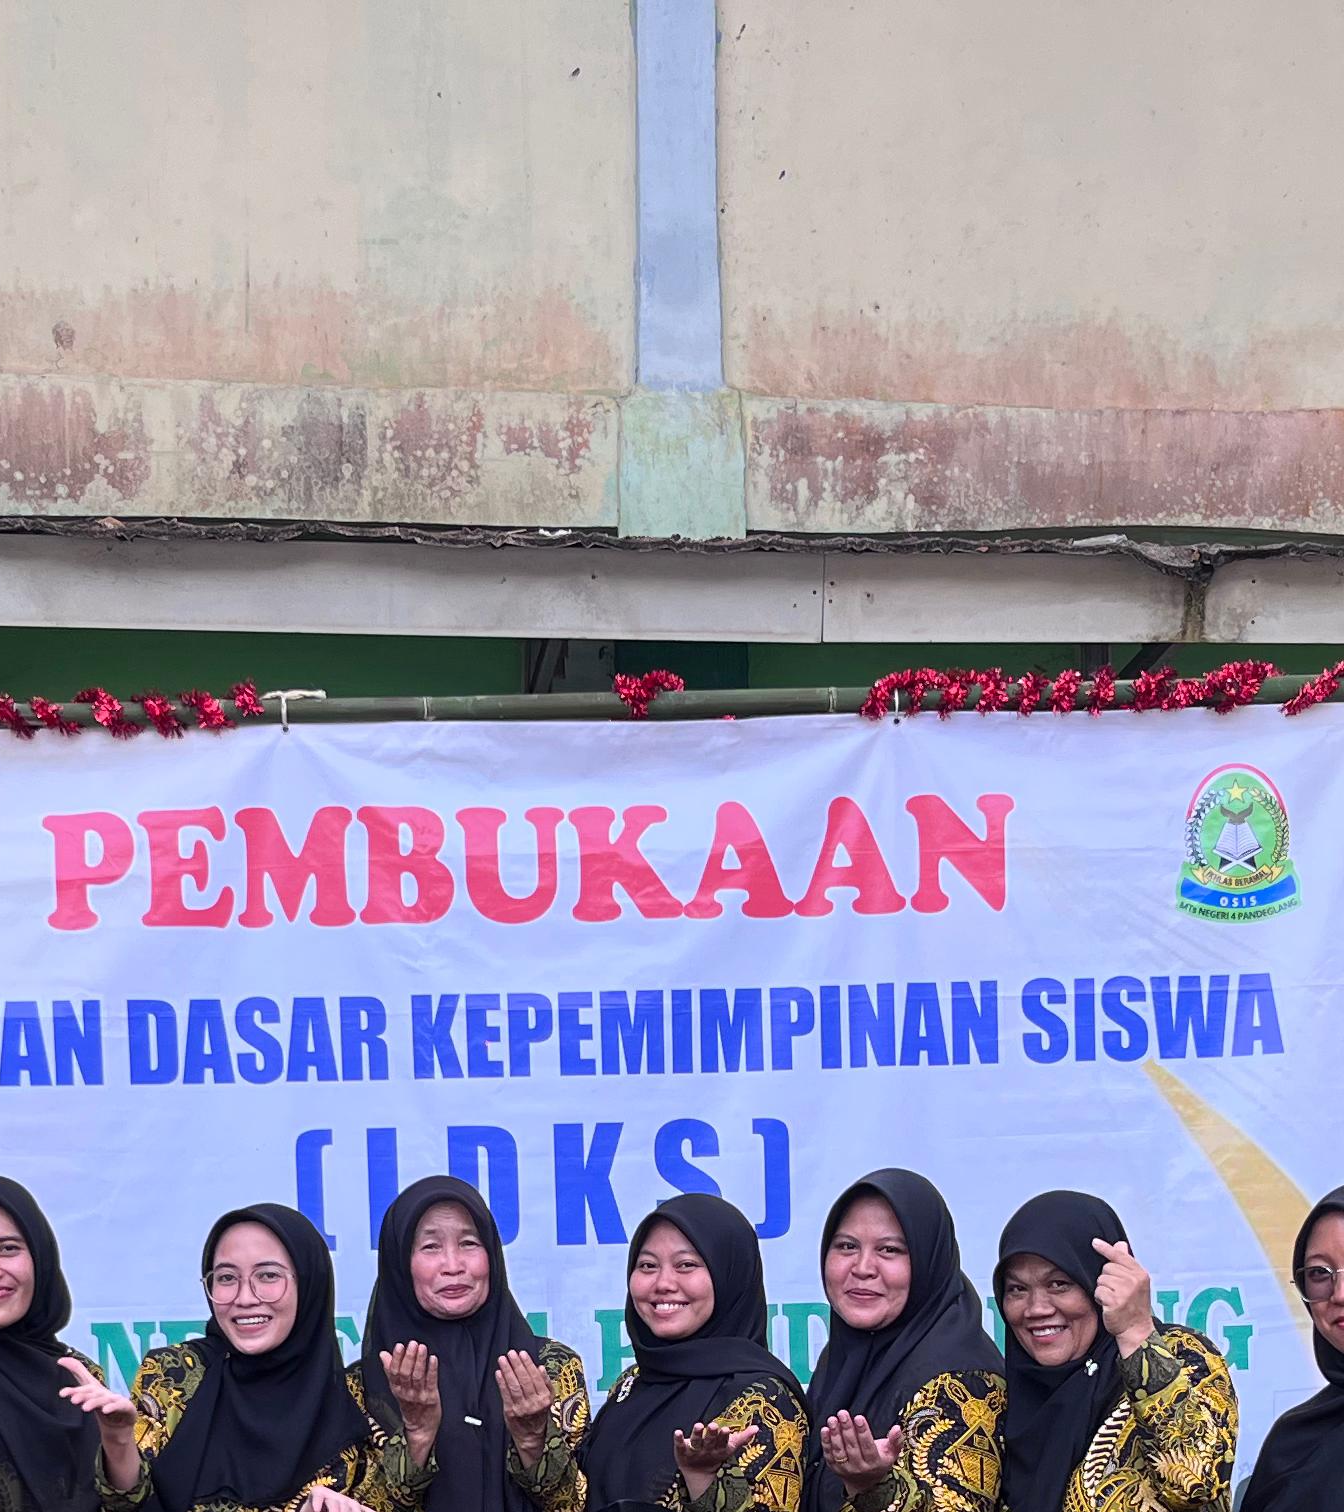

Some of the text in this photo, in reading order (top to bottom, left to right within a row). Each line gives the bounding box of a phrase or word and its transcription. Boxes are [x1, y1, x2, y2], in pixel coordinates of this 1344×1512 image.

[42, 796, 1014, 930] PEMBUKAAN
[1198, 908, 1229, 920] NEGERI
[1237, 898, 1298, 920] PANDEGLANG
[1219, 896, 1257, 907] OSIS
[128, 997, 389, 1085] DASAR
[412, 981, 999, 1081] KEPEMIMPINAN
[1022, 974, 1285, 1065] SISWA
